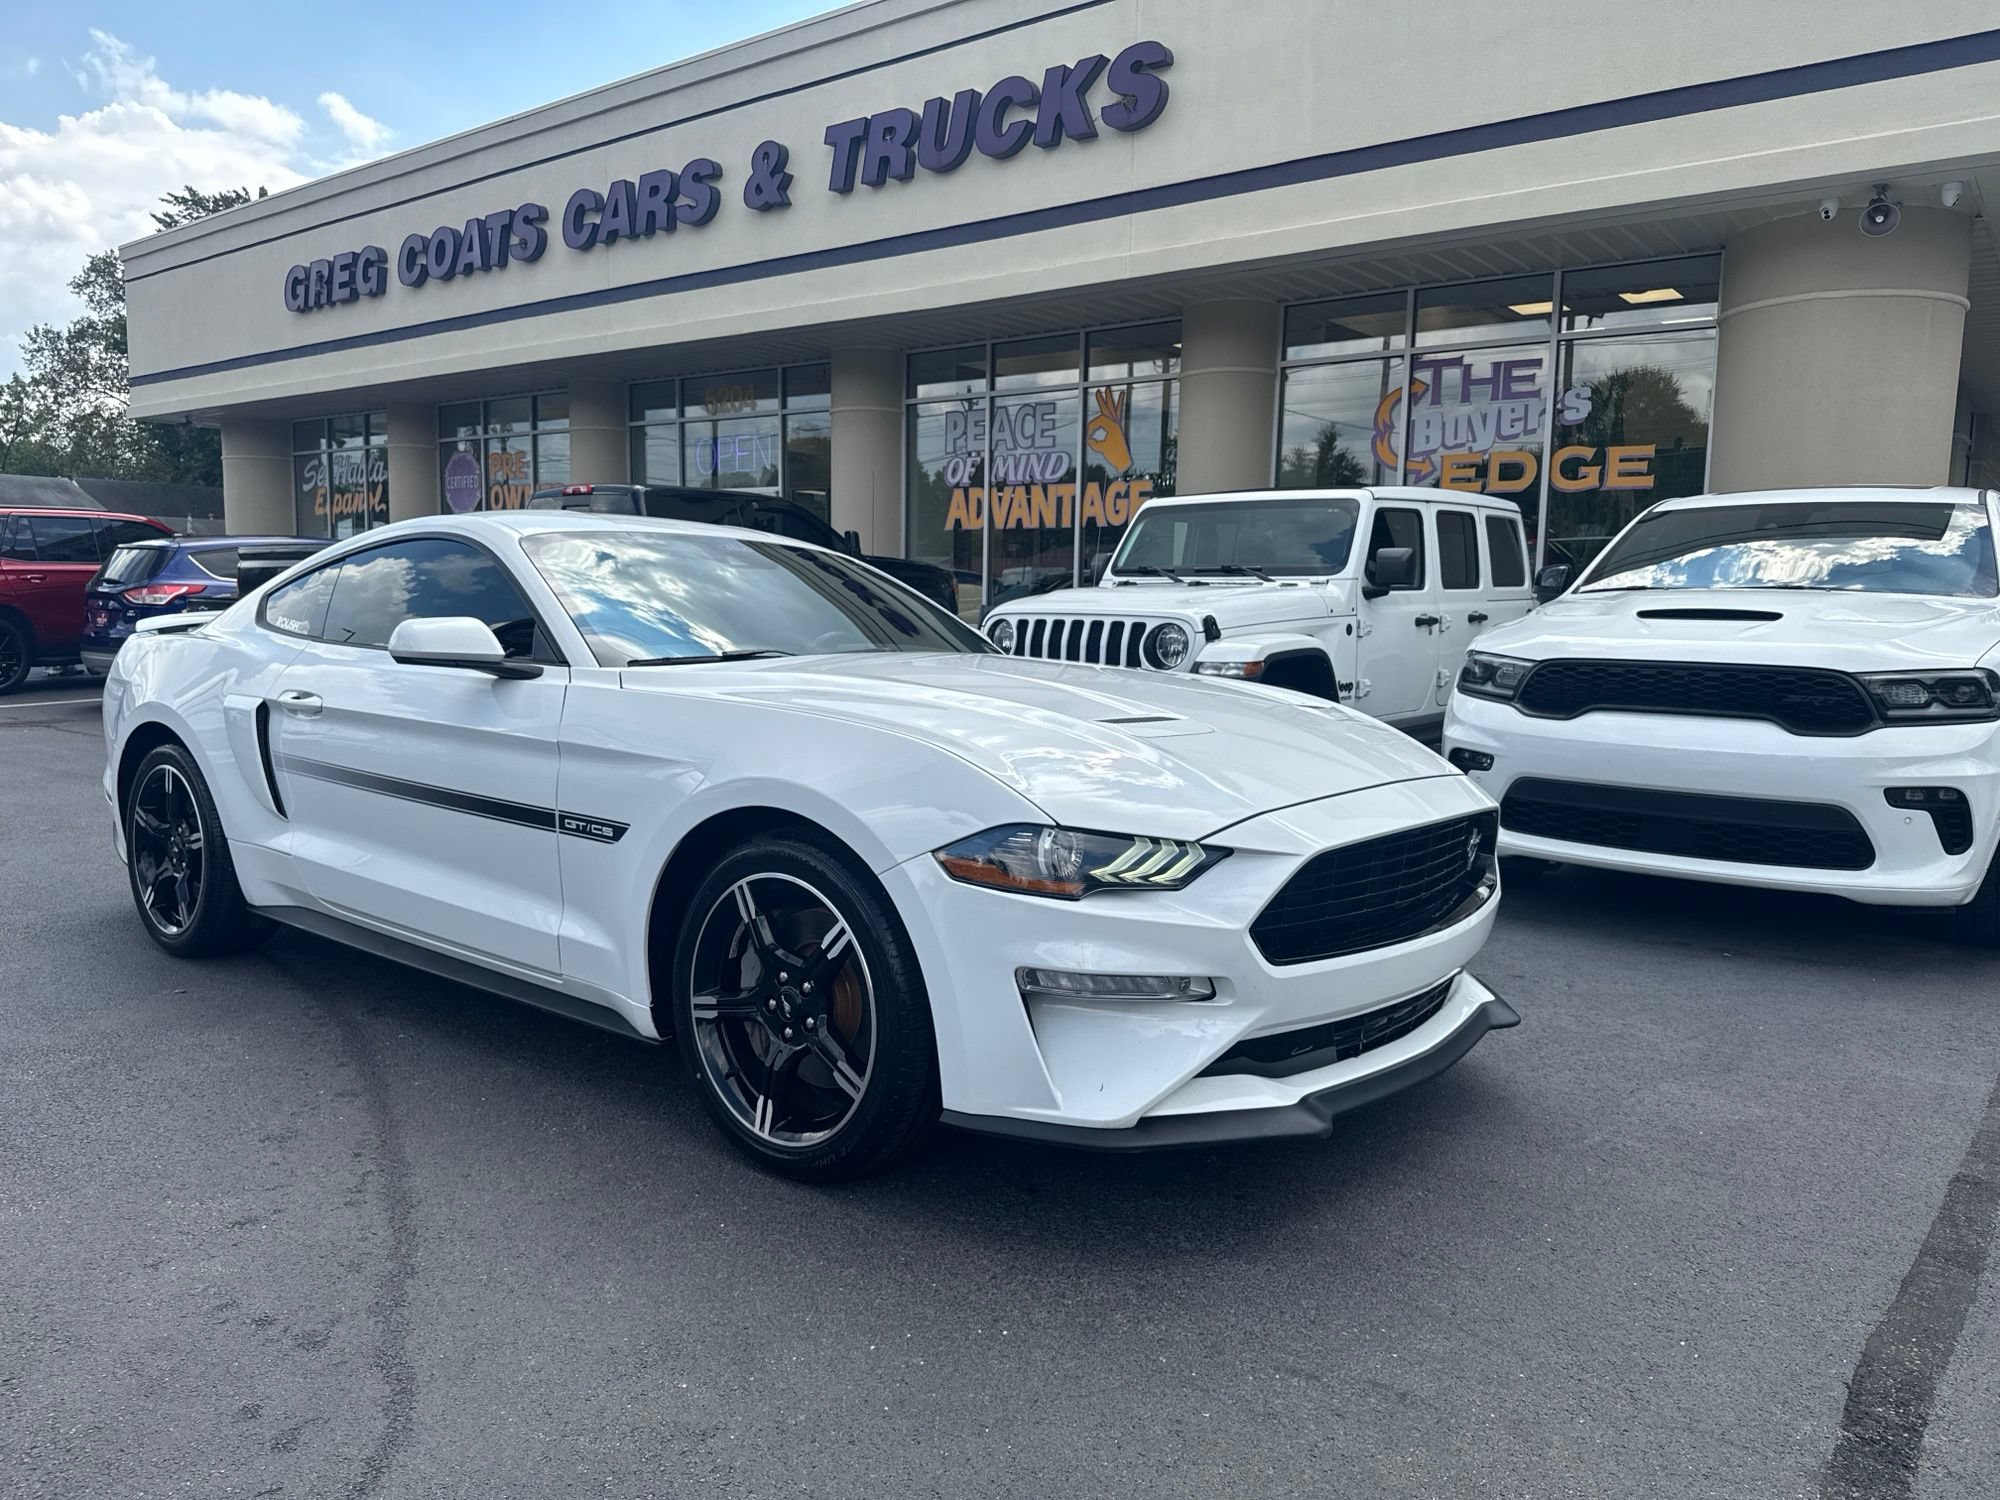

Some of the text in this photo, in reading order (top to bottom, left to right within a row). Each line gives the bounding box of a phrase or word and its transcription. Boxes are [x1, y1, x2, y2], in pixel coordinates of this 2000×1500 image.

[284, 40, 1174, 313] GREG COATS CARS & TRUCKS
[1413, 355, 1543, 407] THE
[945, 402, 1056, 454] PEACE
[303, 452, 387, 492] Se Habla
[695, 435, 772, 474] OPEN
[944, 451, 1071, 486] OF MIND
[1440, 444, 1656, 493] EDGE
[446, 474, 480, 489] CERTIFIED
[945, 480, 1153, 530] ADVANTAGE
[565, 819, 613, 837] GT/CS
